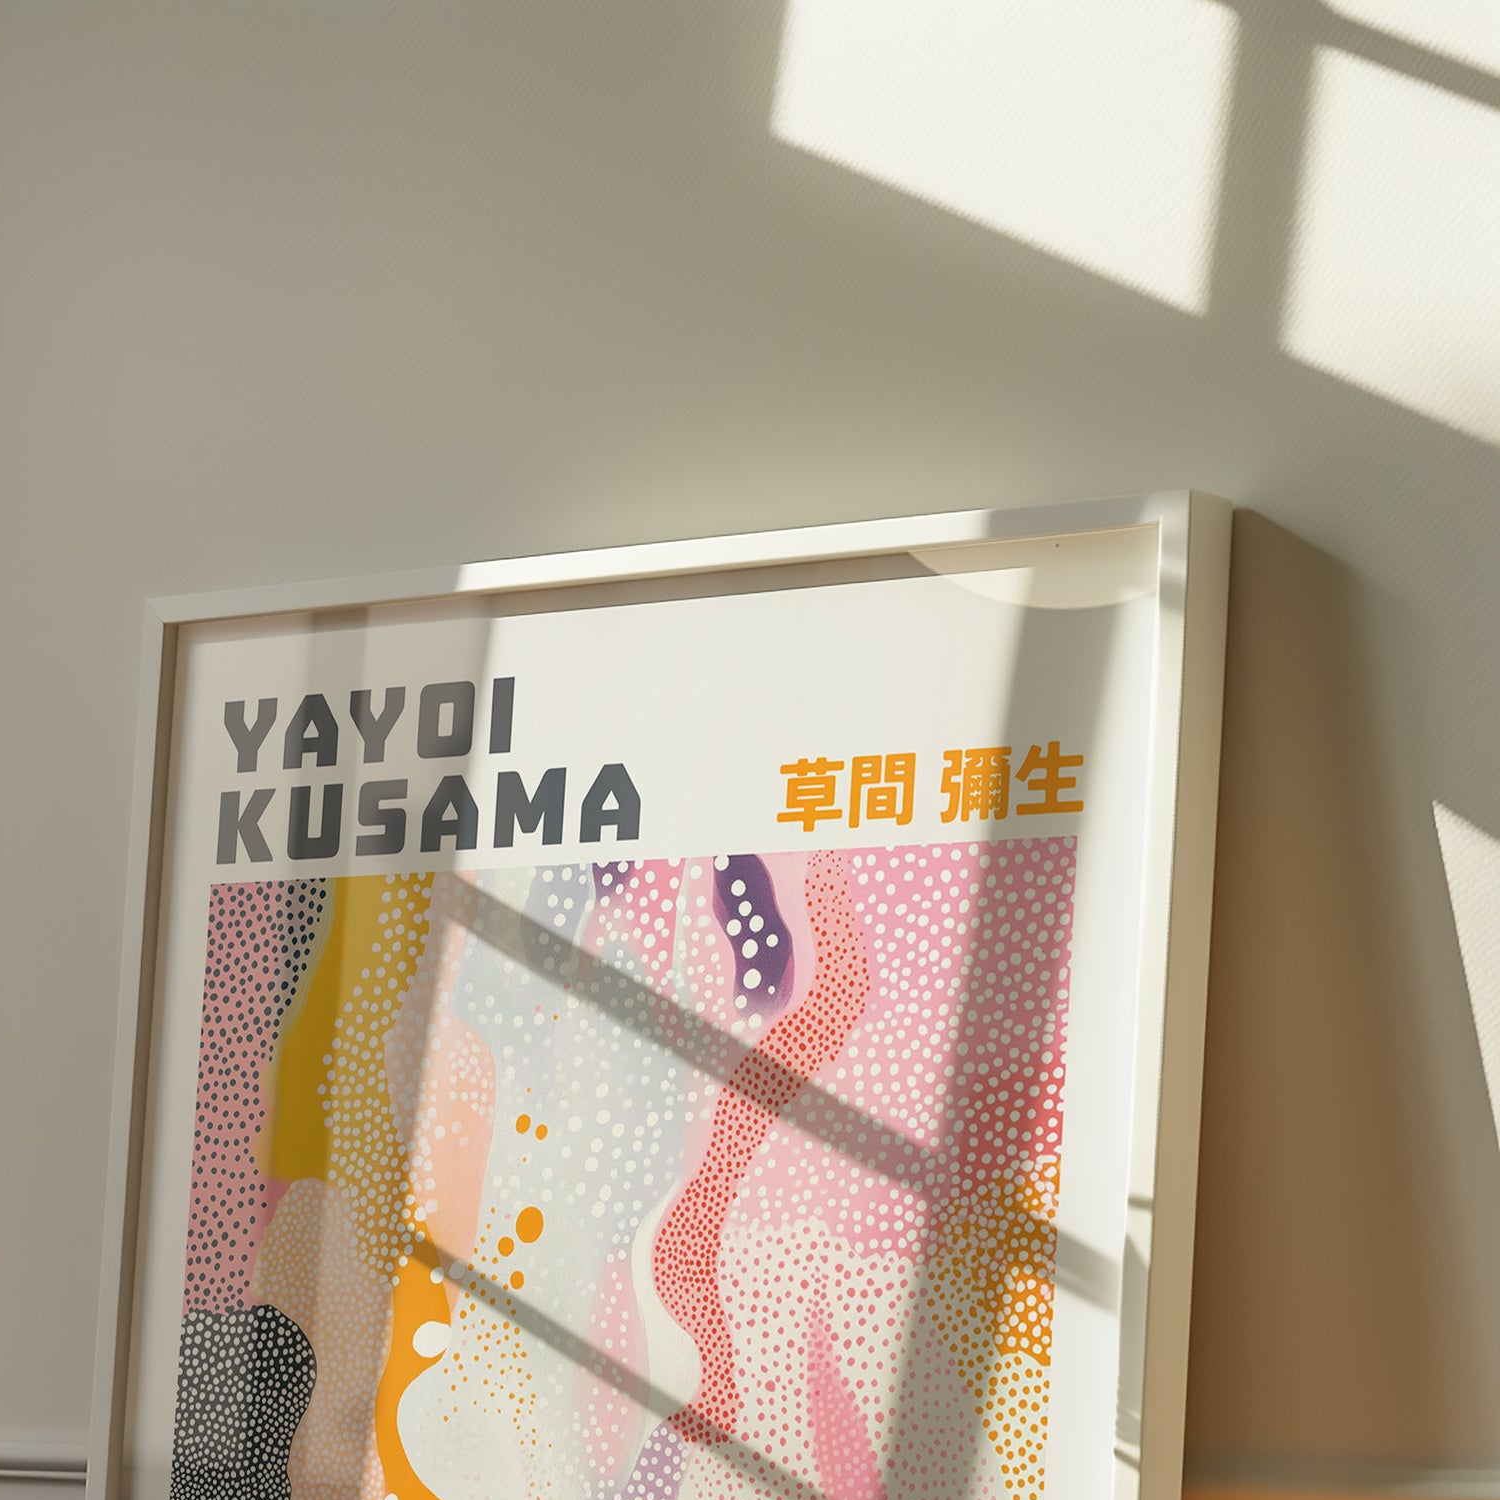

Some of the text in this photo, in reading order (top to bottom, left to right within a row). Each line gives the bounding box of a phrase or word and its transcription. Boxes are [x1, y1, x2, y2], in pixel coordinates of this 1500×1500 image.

[223, 676, 516, 774] YAYOI
[216, 763, 641, 865] KUSAMA
[776, 741, 1084, 832] 草間 彌生
